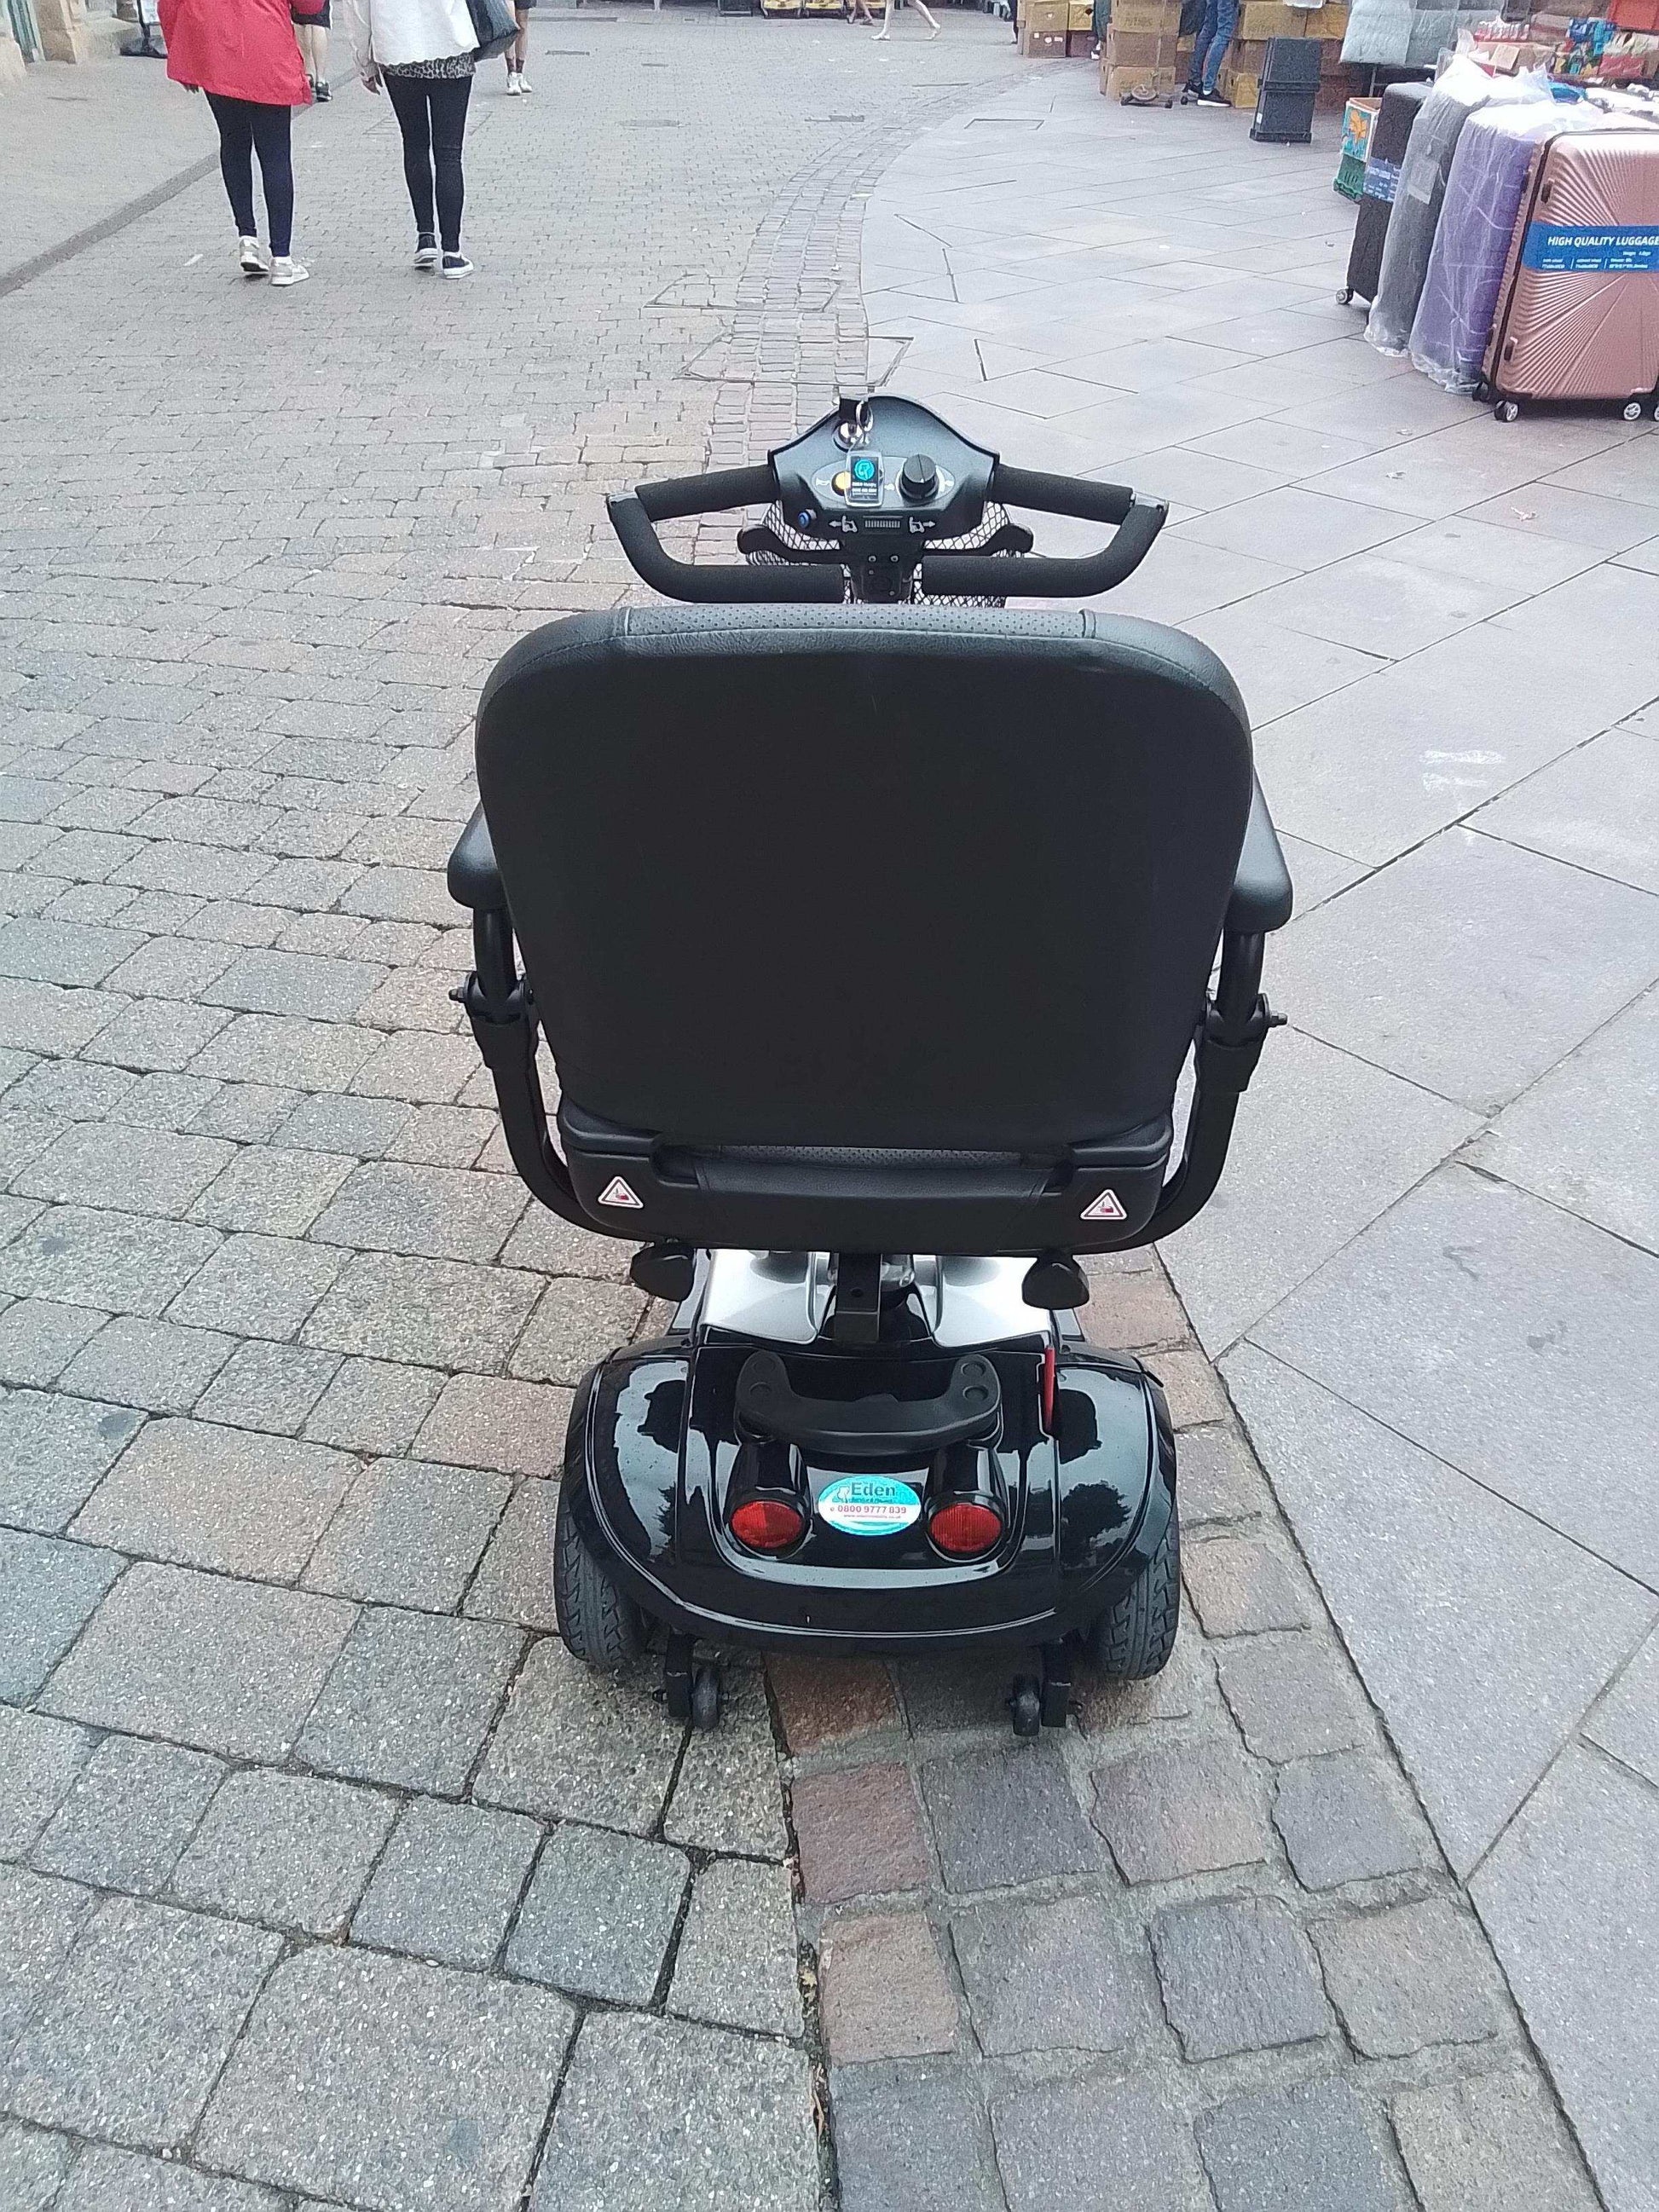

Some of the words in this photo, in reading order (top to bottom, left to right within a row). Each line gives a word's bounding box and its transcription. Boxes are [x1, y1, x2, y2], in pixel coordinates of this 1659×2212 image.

[1547, 236, 1573, 246] HIGH
[1574, 236, 1616, 247] QUALITY
[851, 1482, 895, 1496] Eden
[837, 1505, 862, 1513] 0800
[864, 1505, 887, 1514] 9777
